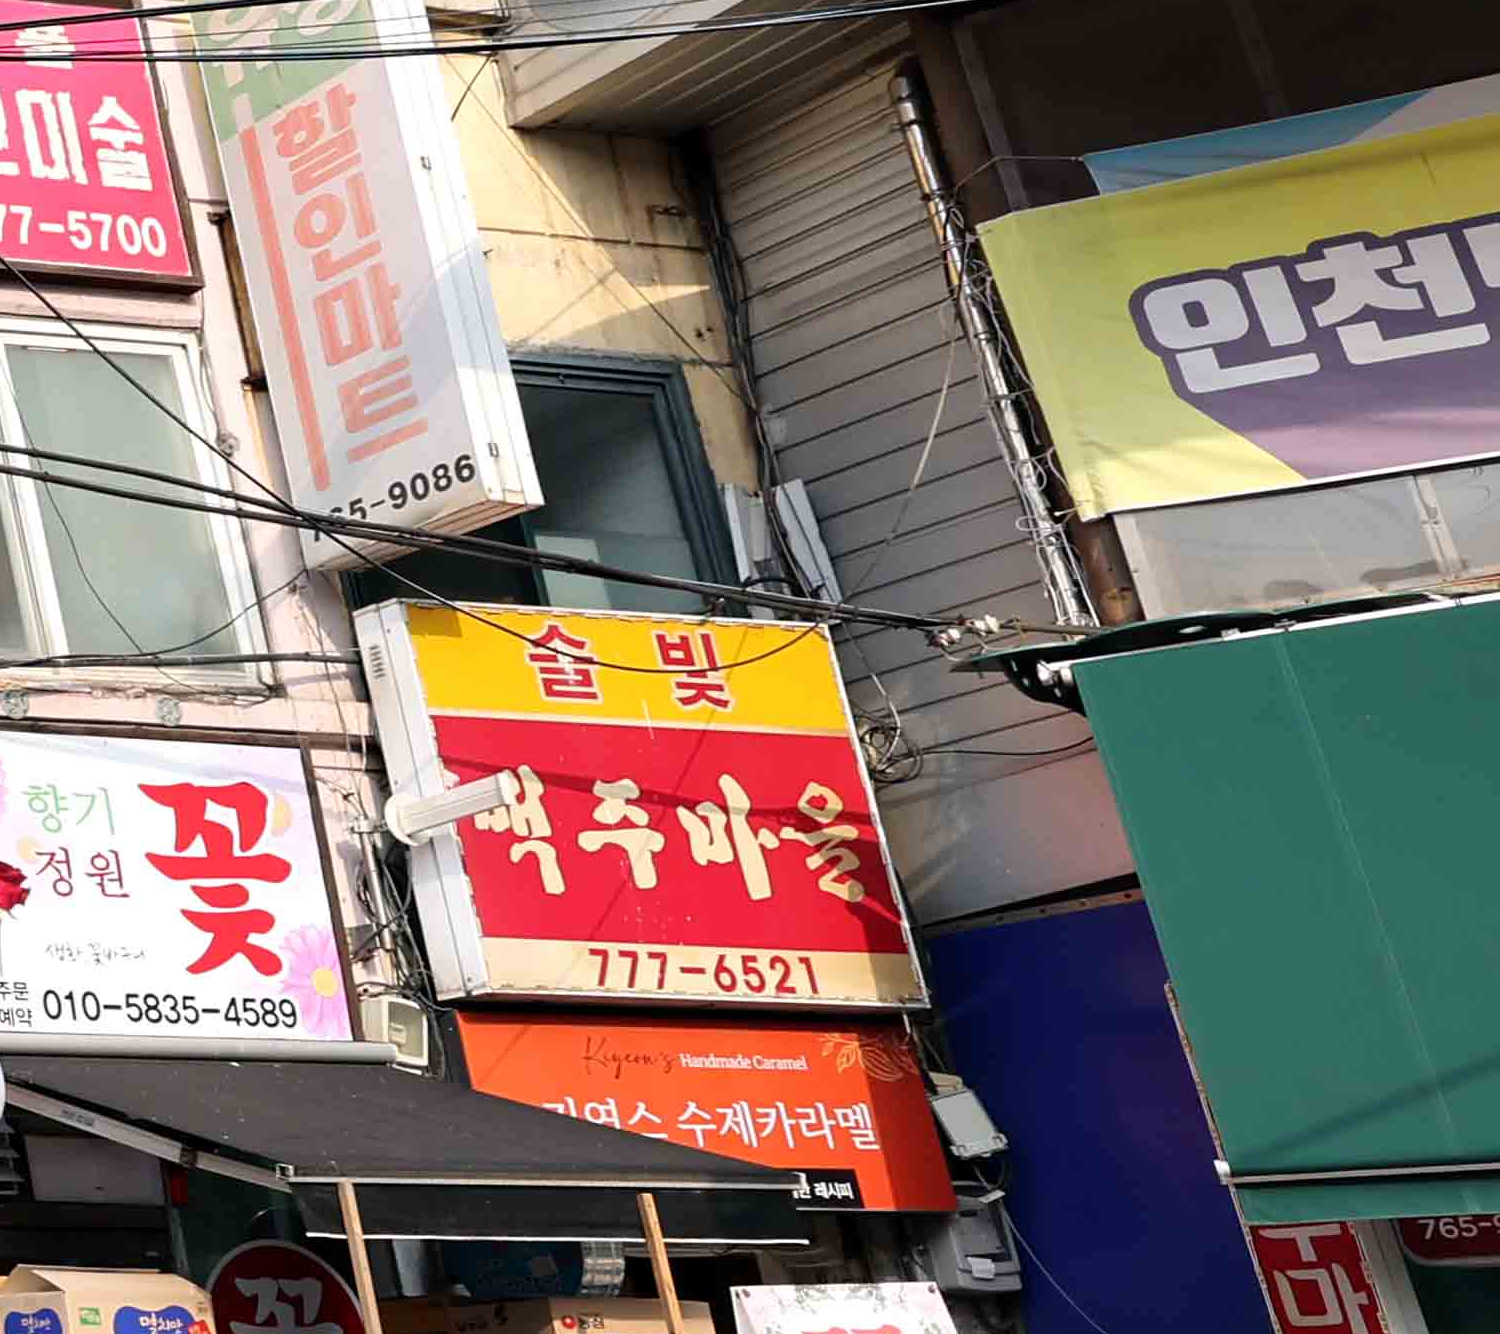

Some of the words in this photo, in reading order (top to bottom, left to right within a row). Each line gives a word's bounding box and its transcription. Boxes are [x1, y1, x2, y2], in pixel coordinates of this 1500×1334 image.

[273, 82, 429, 464] 할인마트
[1143, 223, 1500, 395] 인천
[21, 783, 117, 837] 향기
[34, 846, 130, 899] 정원
[138, 781, 293, 977] 꽃
[587, 947, 821, 995] 777-6521
[42, 988, 298, 1030] 010-5835-4589
[679, 1052, 752, 1070] Handmade
[752, 1053, 809, 1071] Caramel
[676, 1100, 882, 1151] 수제카라멜
